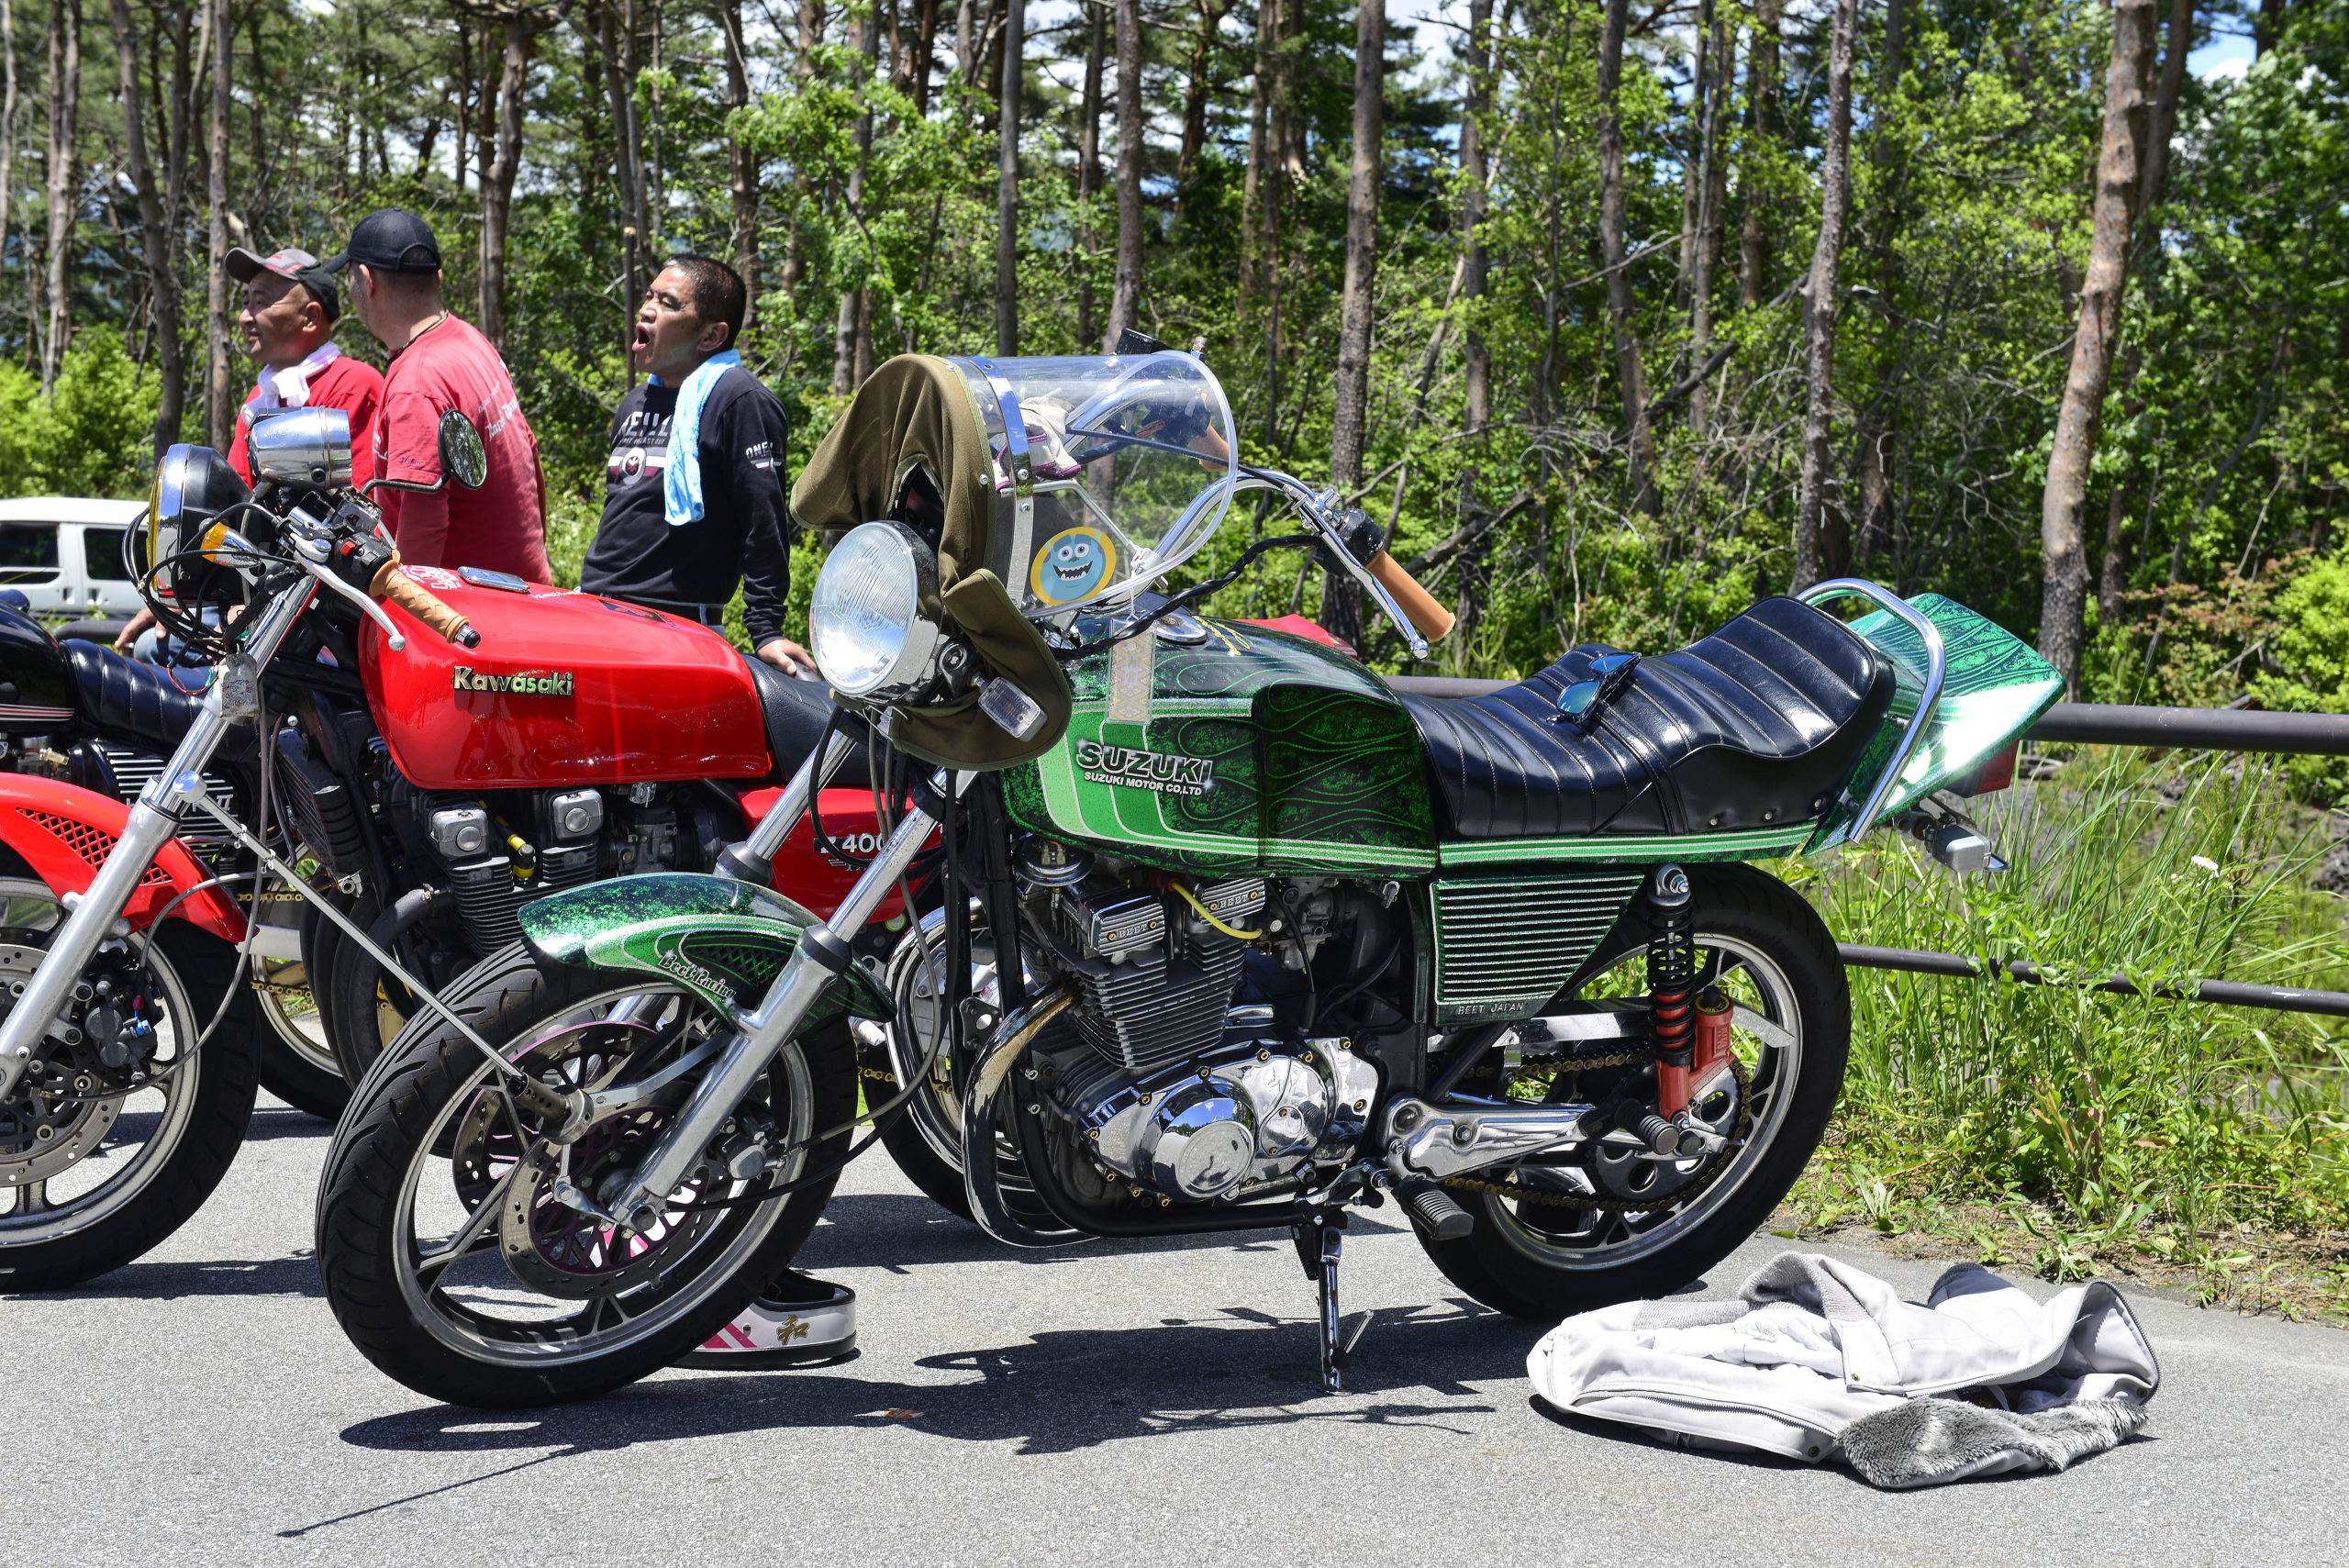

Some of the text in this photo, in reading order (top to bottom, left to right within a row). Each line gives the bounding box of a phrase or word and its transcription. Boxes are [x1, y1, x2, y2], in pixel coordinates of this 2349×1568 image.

[453, 665, 573, 696] Kawasaki
[1075, 741, 1213, 785] SUZUKI
[1084, 772, 1124, 785] SUZUKI
[1126, 777, 1163, 791] MOTOR
[1219, 895, 1248, 909] BEET
[1119, 924, 1147, 938] BEET
[658, 952, 697, 979] Beet
[1457, 1002, 1524, 1015] BEET JAPAN
[776, 1314, 810, 1346] 和
